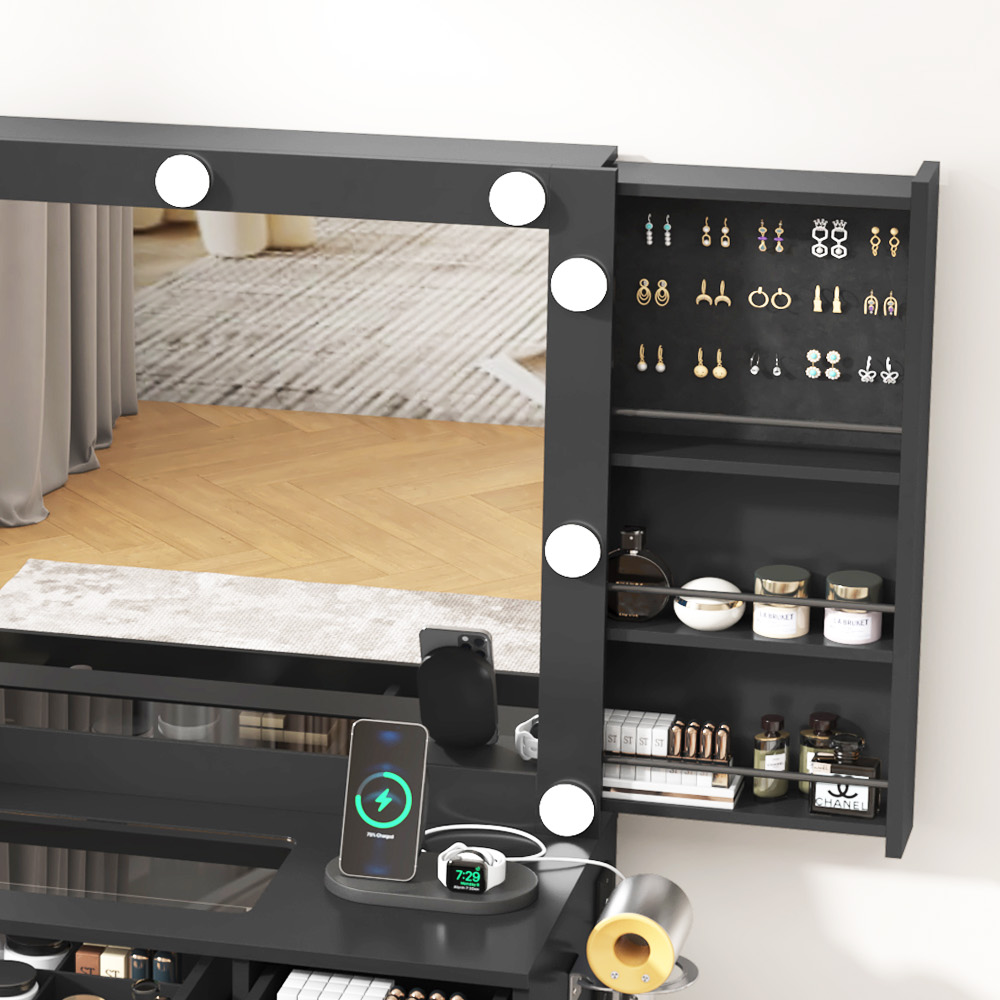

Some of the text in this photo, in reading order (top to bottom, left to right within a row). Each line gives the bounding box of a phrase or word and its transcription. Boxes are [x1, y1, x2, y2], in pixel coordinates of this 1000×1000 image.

[608, 734, 617, 743] ST
[624, 736, 633, 744] ST
[640, 737, 649, 746] ST
[655, 739, 664, 747] ST
[815, 797, 868, 811] CHANEL
[456, 869, 480, 882] 7:29
